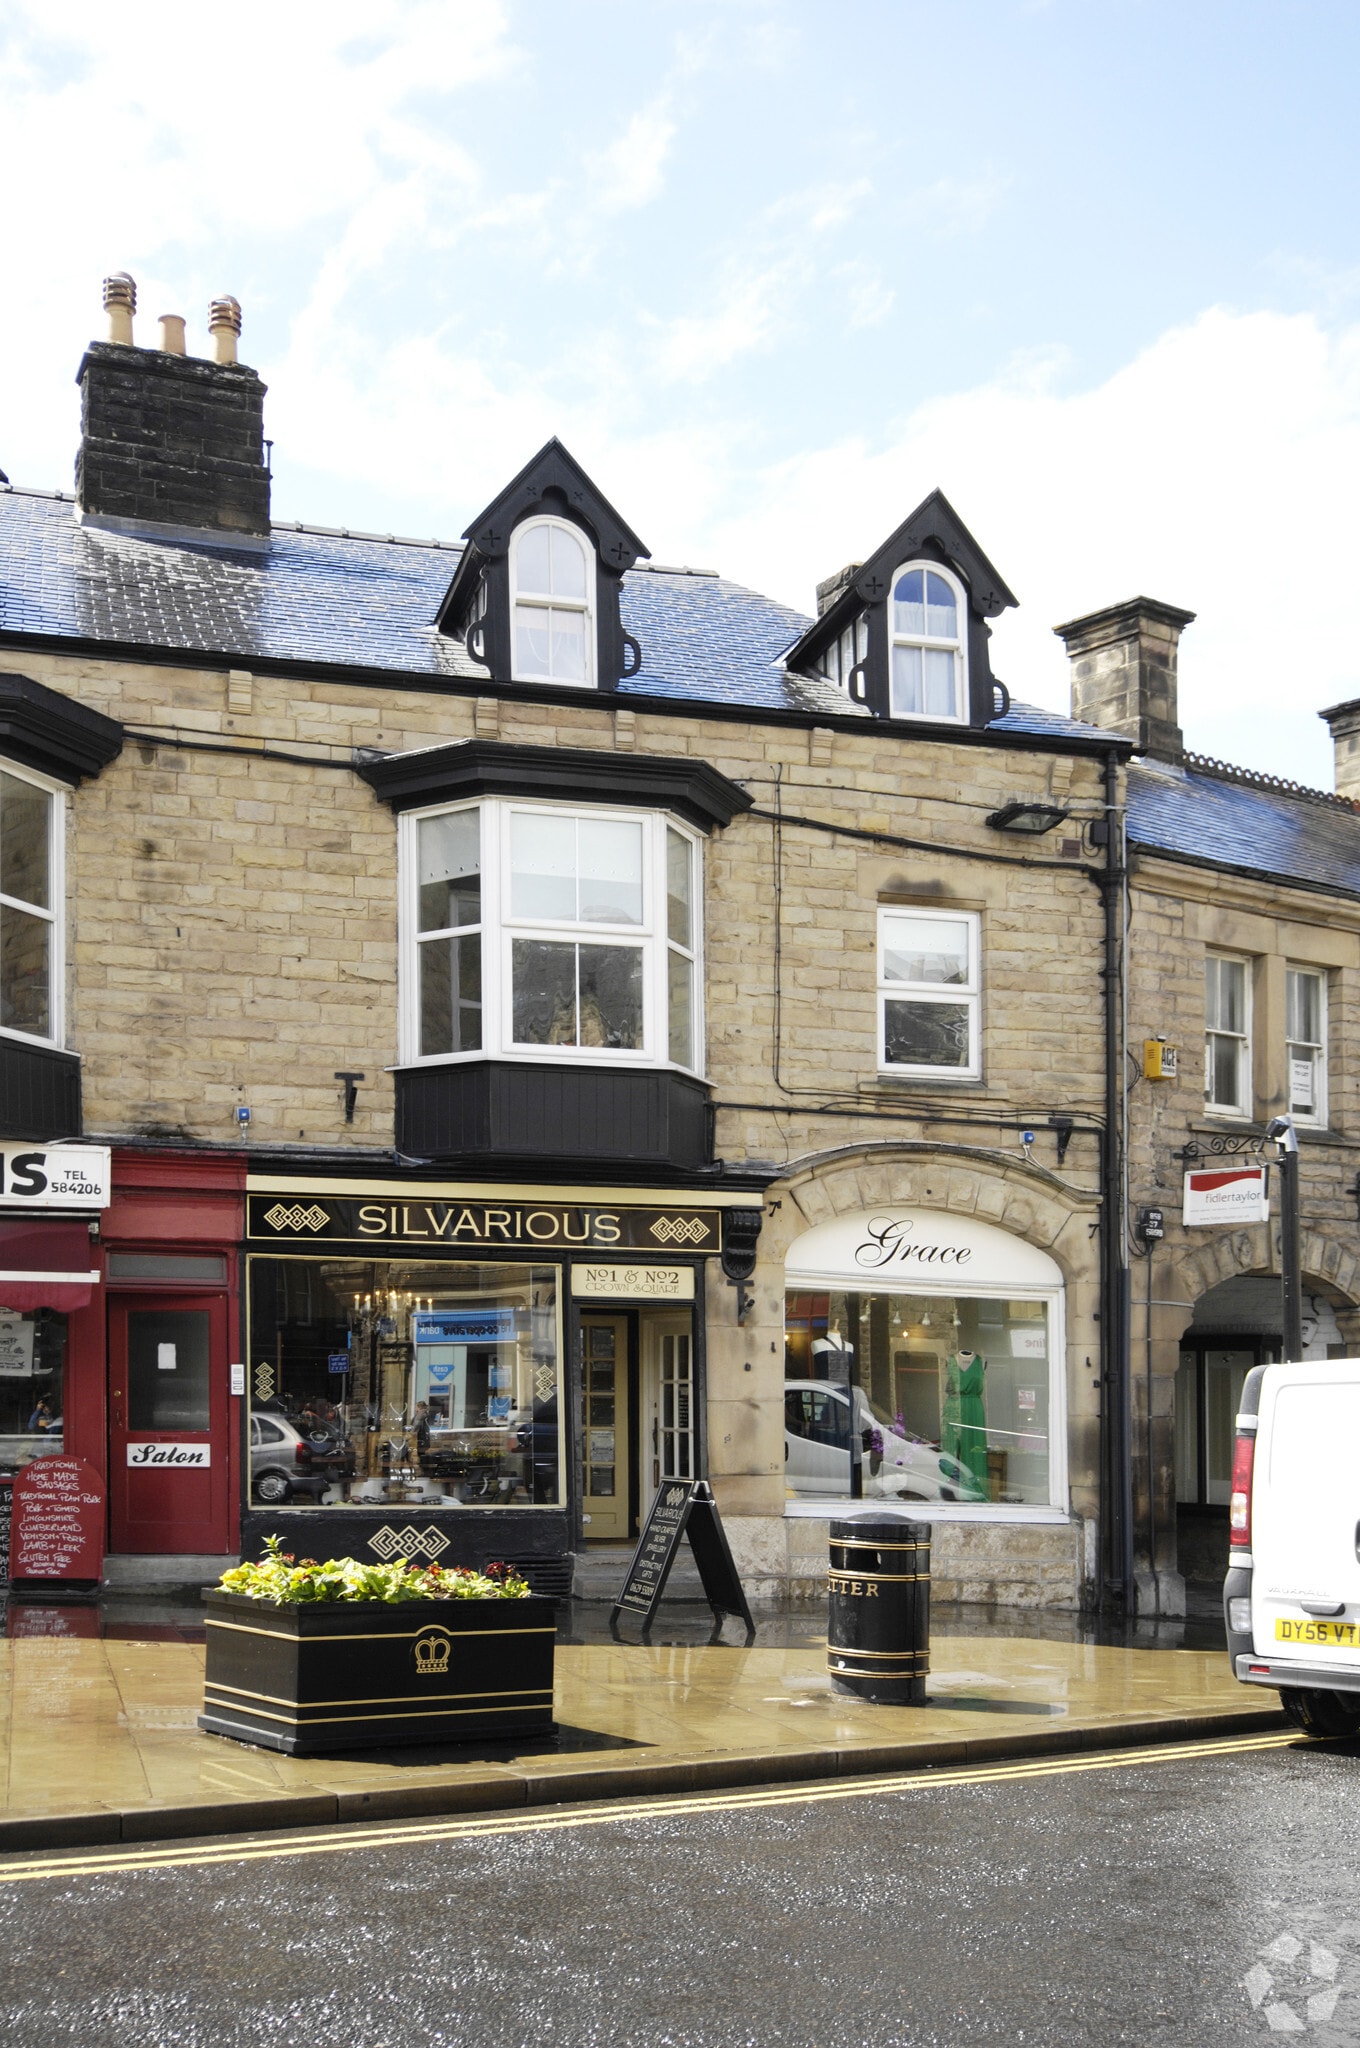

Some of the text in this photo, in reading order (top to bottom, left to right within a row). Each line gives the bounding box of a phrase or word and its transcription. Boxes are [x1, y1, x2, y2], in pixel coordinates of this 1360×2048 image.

[1162, 1046, 1176, 1067] ACE
[0, 1152, 48, 1196] S
[64, 1170, 87, 1180] TEL
[51, 1182, 102, 1195] 584206
[1205, 1191, 1261, 1204] fidlertaylor
[358, 1205, 621, 1242] SILVARIOUS
[855, 1216, 971, 1268] Grace
[624, 1270, 639, 1284] &
[585, 1283, 679, 1295] CROWN SQUARE
[132, 1445, 204, 1463] Salon
[31, 1460, 82, 1471] TRADITIONAL
[26, 1471, 79, 1481] HOME MADE
[36, 1481, 79, 1491] SAUSAGES
[17, 1491, 101, 1503] TRADITIONAL PLAIN PORK
[21, 1501, 43, 1512] PORK
[50, 1504, 80, 1513] TOMATO
[23, 1514, 75, 1522] LINCOLNSHIRE
[19, 1522, 82, 1532] CUMBERLAND
[20, 1533, 55, 1541] VENISON
[59, 1533, 86, 1543] PORK
[23, 1541, 48, 1550] LAMB
[57, 1543, 81, 1553] LEEK
[18, 1551, 72, 1563] GLUTEN FREE
[1281, 1621, 1360, 1644] DY56 VT
